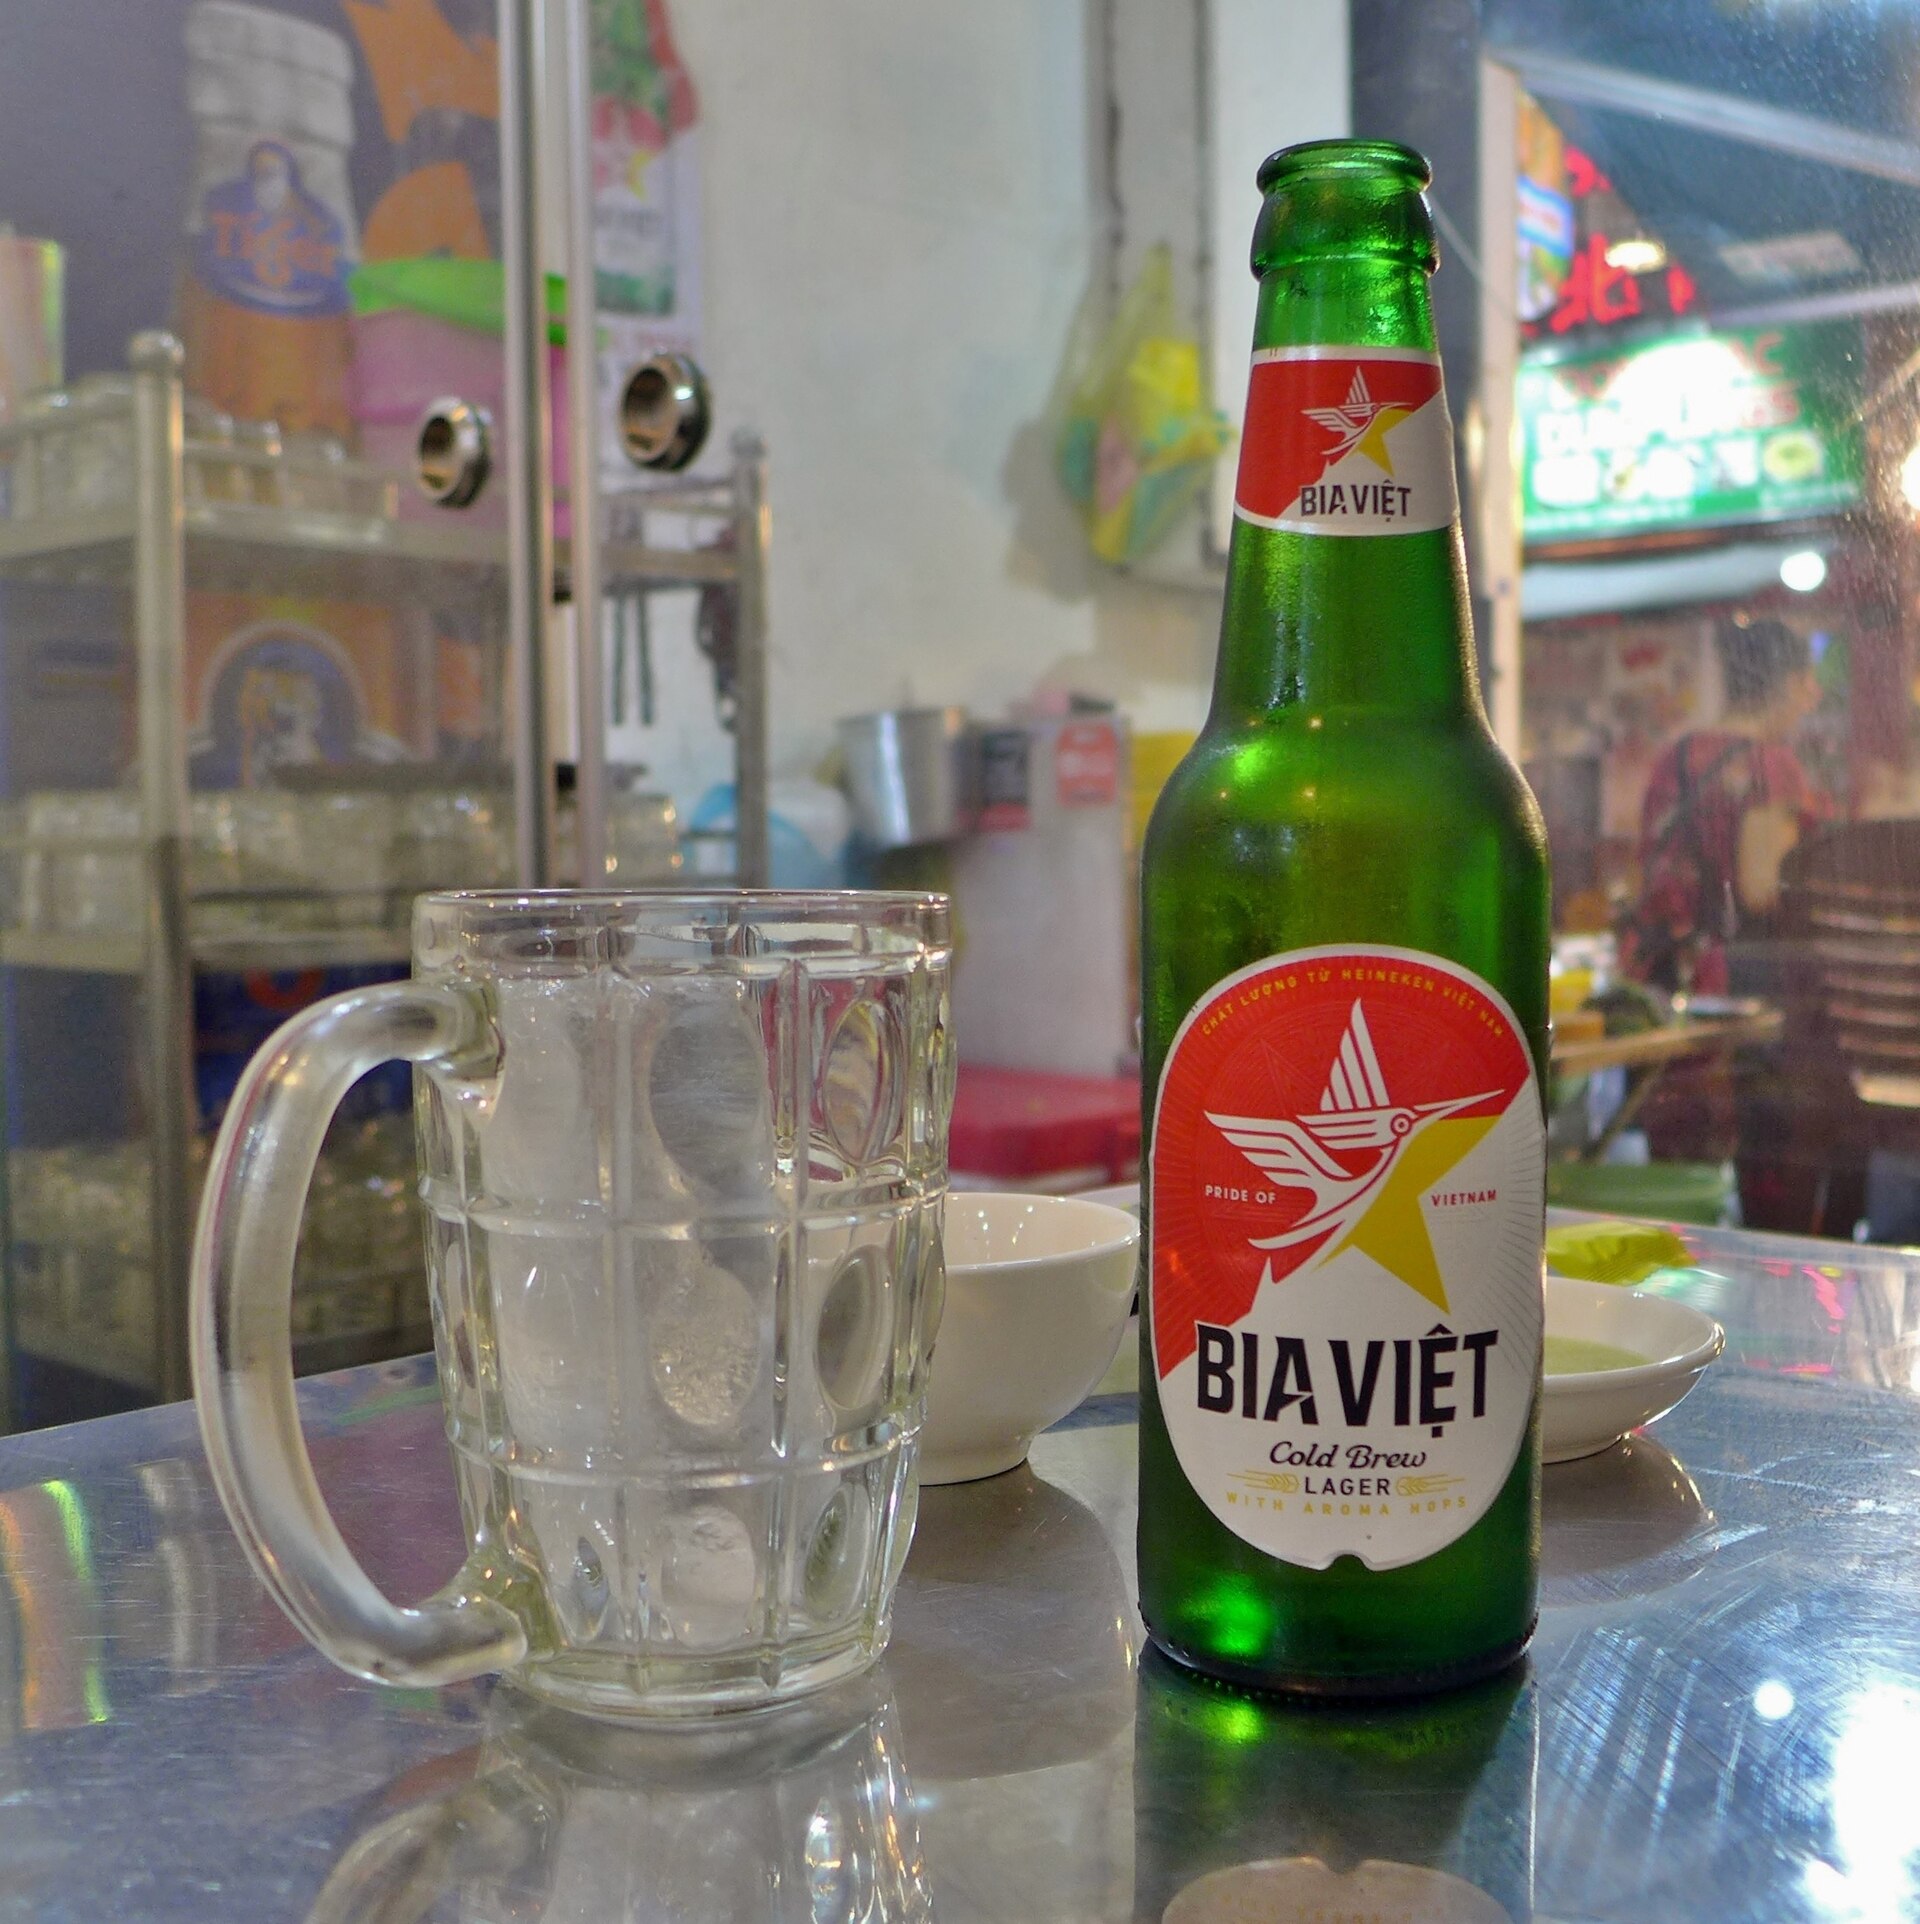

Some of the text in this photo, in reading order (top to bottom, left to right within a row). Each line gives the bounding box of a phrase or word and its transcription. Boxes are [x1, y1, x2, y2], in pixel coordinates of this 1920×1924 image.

[1300, 478, 1412, 523] BIA VIỆT
[1341, 968, 1436, 992] HEINEKEN
[1204, 1184, 1498, 1208] PRIDE OF VIETNAM
[1196, 1322, 1499, 1439] BIA VIỆT
[1269, 1440, 1427, 1469] Cold Brew
[1304, 1477, 1391, 1497] LAGER
[1226, 1491, 1467, 1516] WITH AROMA HOPS
